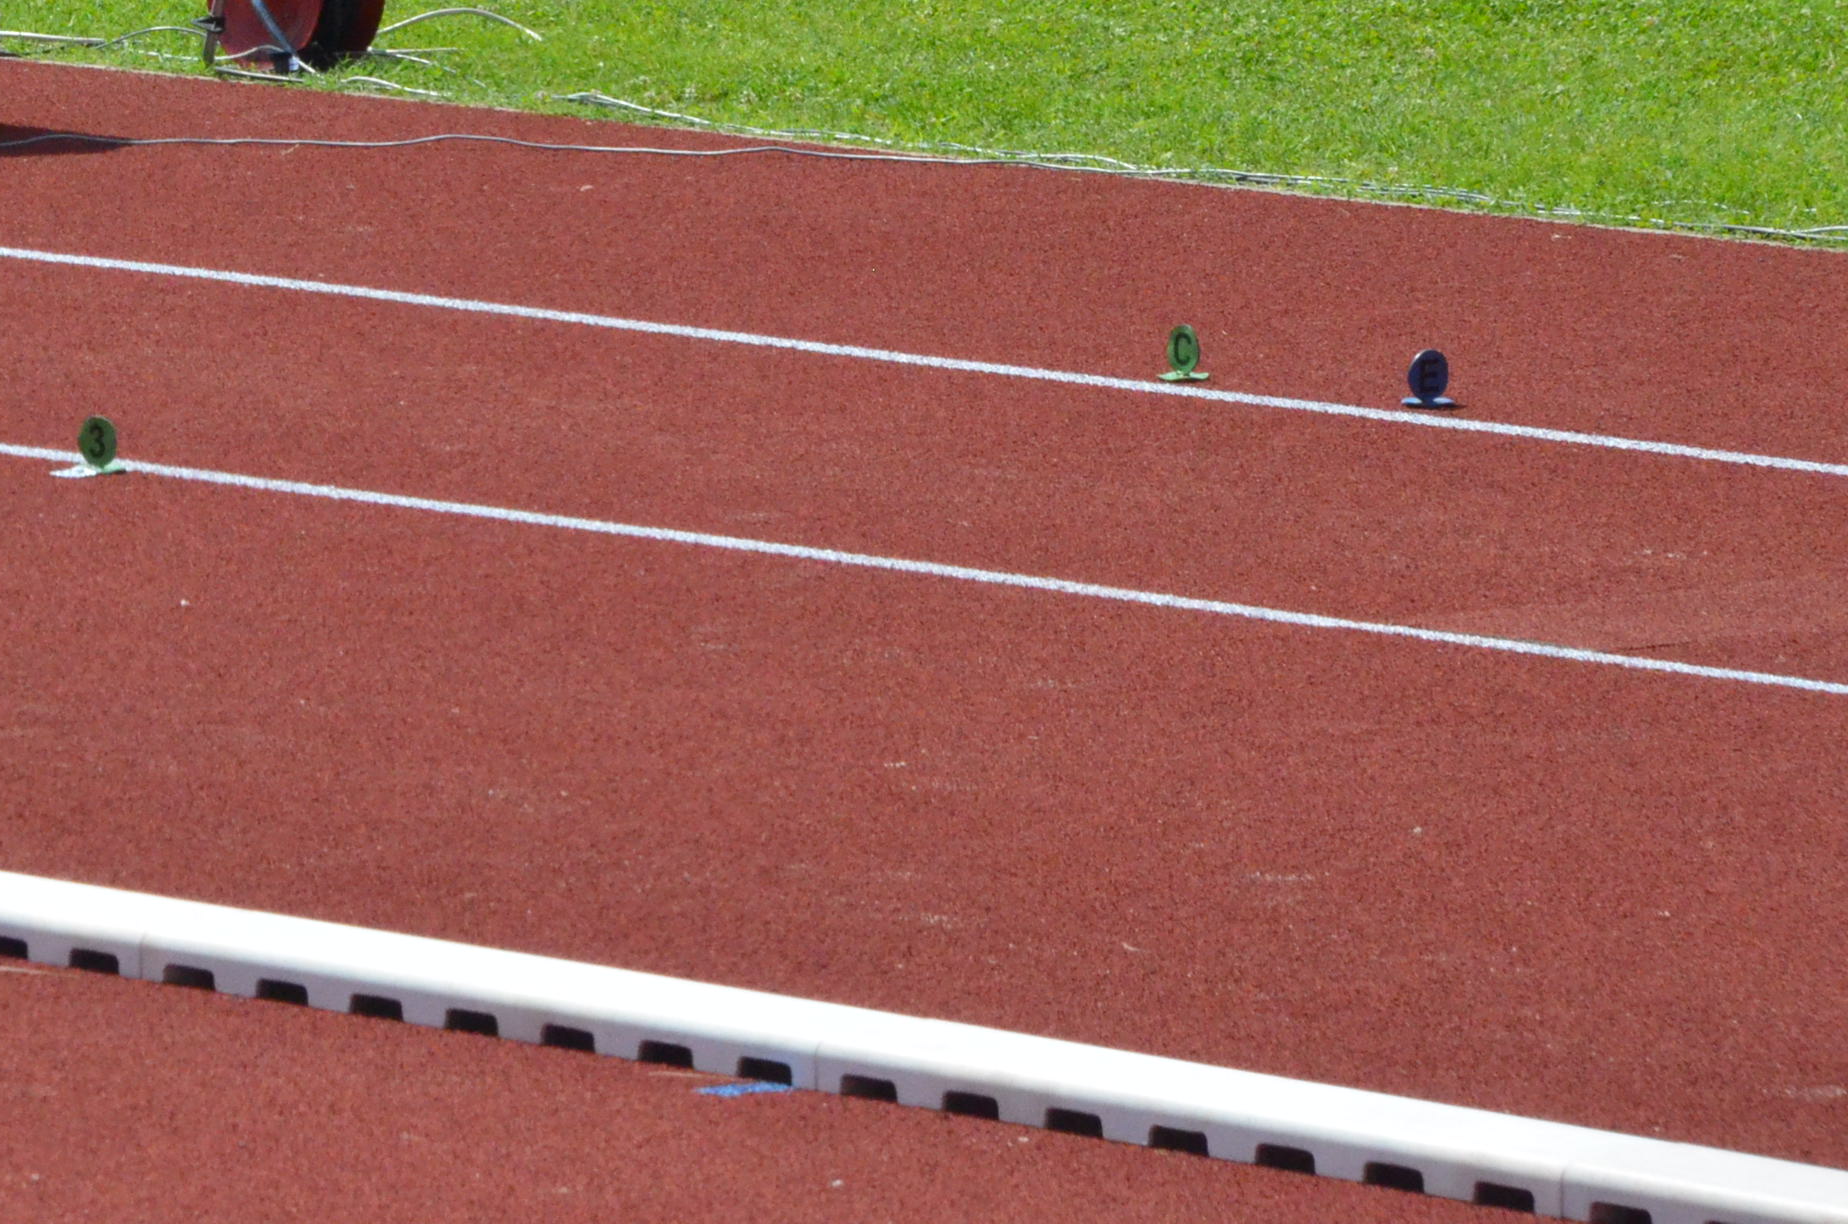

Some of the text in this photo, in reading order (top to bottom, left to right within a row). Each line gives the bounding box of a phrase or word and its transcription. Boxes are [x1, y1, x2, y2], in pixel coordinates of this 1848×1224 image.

[1174, 332, 1191, 366] C
[1419, 359, 1440, 392] E
[89, 424, 105, 458] 3
